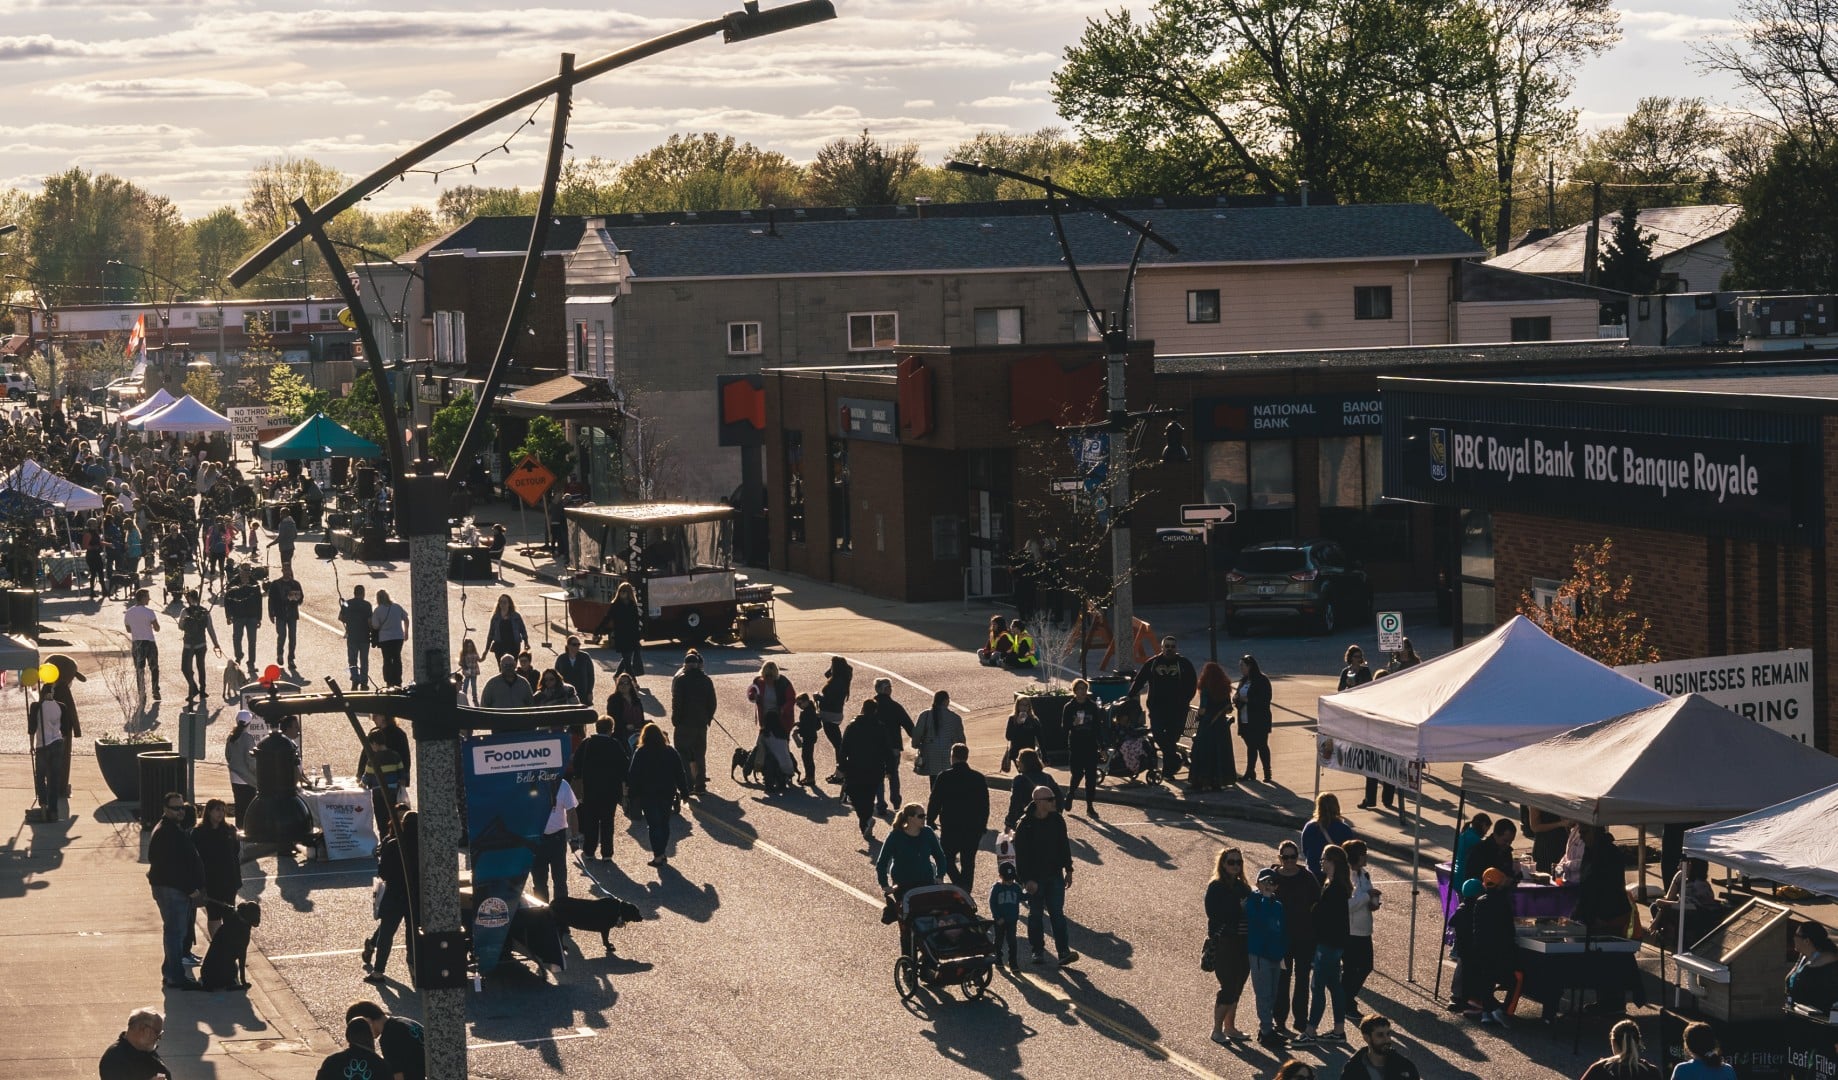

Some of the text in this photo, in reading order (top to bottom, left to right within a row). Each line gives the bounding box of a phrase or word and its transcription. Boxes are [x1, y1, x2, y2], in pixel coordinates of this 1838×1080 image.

[247, 408, 279, 416] THROUH
[1253, 403, 1316, 416] NATIONAL
[231, 416, 254, 424] TRUCK
[1254, 417, 1289, 429] BANK
[1343, 413, 1382, 426] NATIO
[236, 425, 259, 433] TRUCK
[1432, 464, 1444, 476] RBC
[1454, 434, 1758, 504] RBC Royal Bank RBC Banque Royale
[515, 477, 546, 487] DETOUR
[1654, 661, 1809, 696] BUSINESSES REMAIN
[484, 747, 551, 763] FOODLAND
[516, 770, 559, 783] Belle River
[1752, 1052, 1784, 1065] Filter
[1788, 1046, 1809, 1068] Leaf
[1815, 1054, 1836, 1077] Filter
